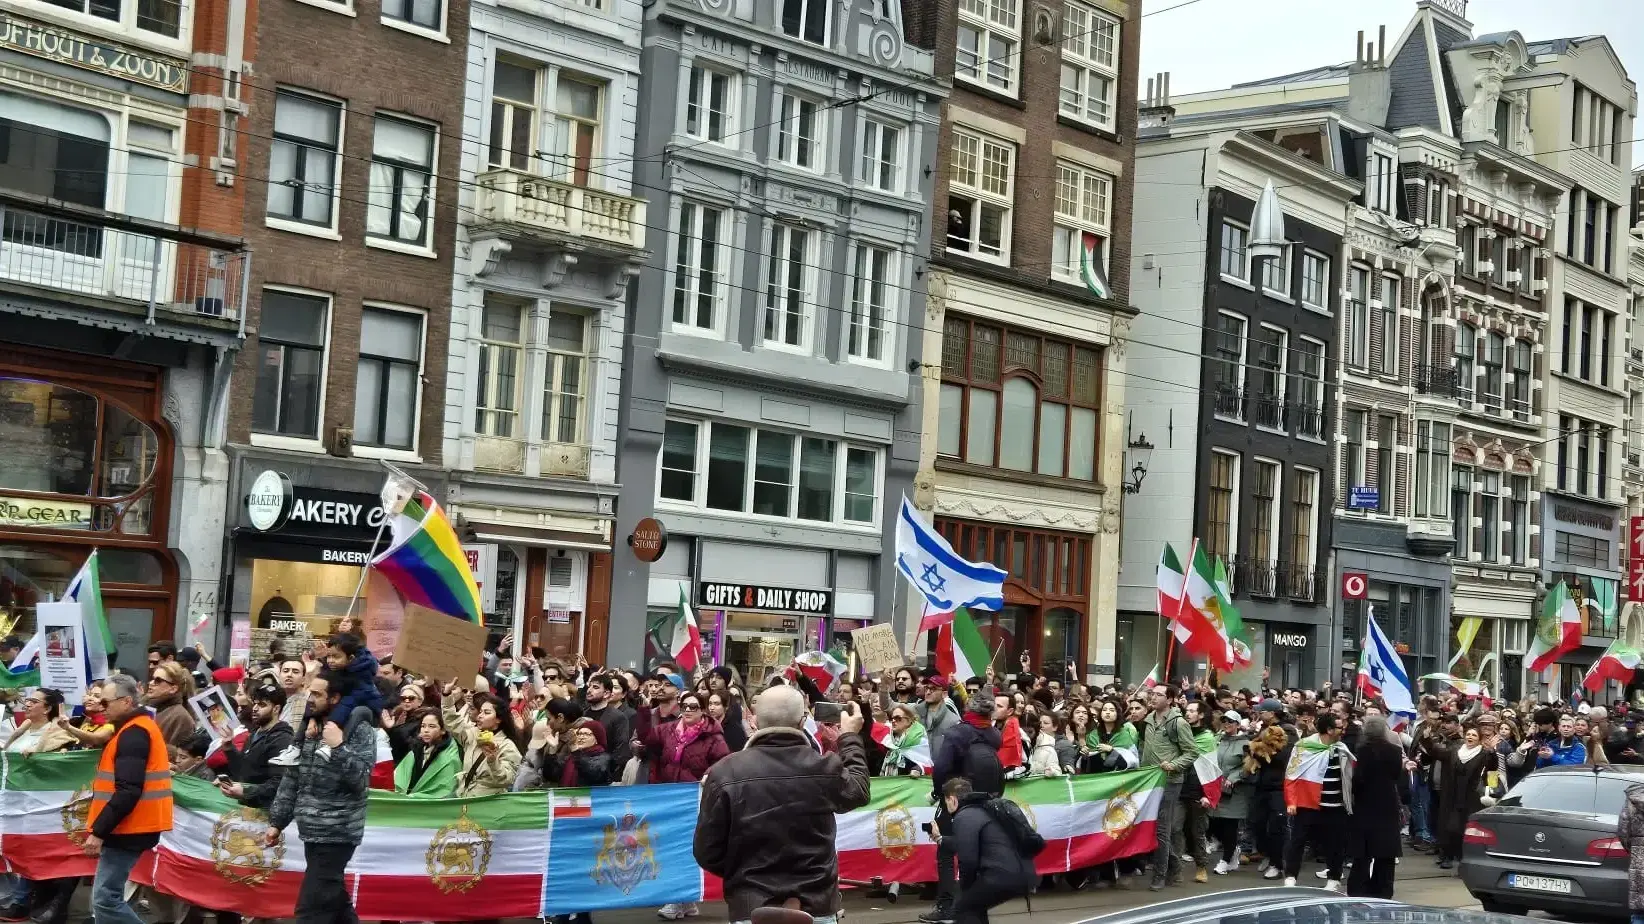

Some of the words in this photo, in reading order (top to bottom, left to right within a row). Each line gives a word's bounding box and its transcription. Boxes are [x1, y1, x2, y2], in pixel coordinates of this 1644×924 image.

[90, 47, 107, 67] &
[110, 47, 170, 84] ZOON
[250, 494, 282, 507] BAKERY
[27, 507, 81, 522] GEAR
[291, 499, 362, 526] AKERY
[634, 539, 659, 550] STONE
[323, 549, 370, 563] BAKERY
[192, 591, 215, 607] 44
[706, 584, 741, 605] GIFTS
[744, 587, 753, 606] &
[757, 588, 792, 609] DAILY
[794, 591, 826, 611] SHOP
[270, 619, 309, 632] BAKERY
[857, 633, 870, 646] NO
[1273, 633, 1307, 647] MANGO
